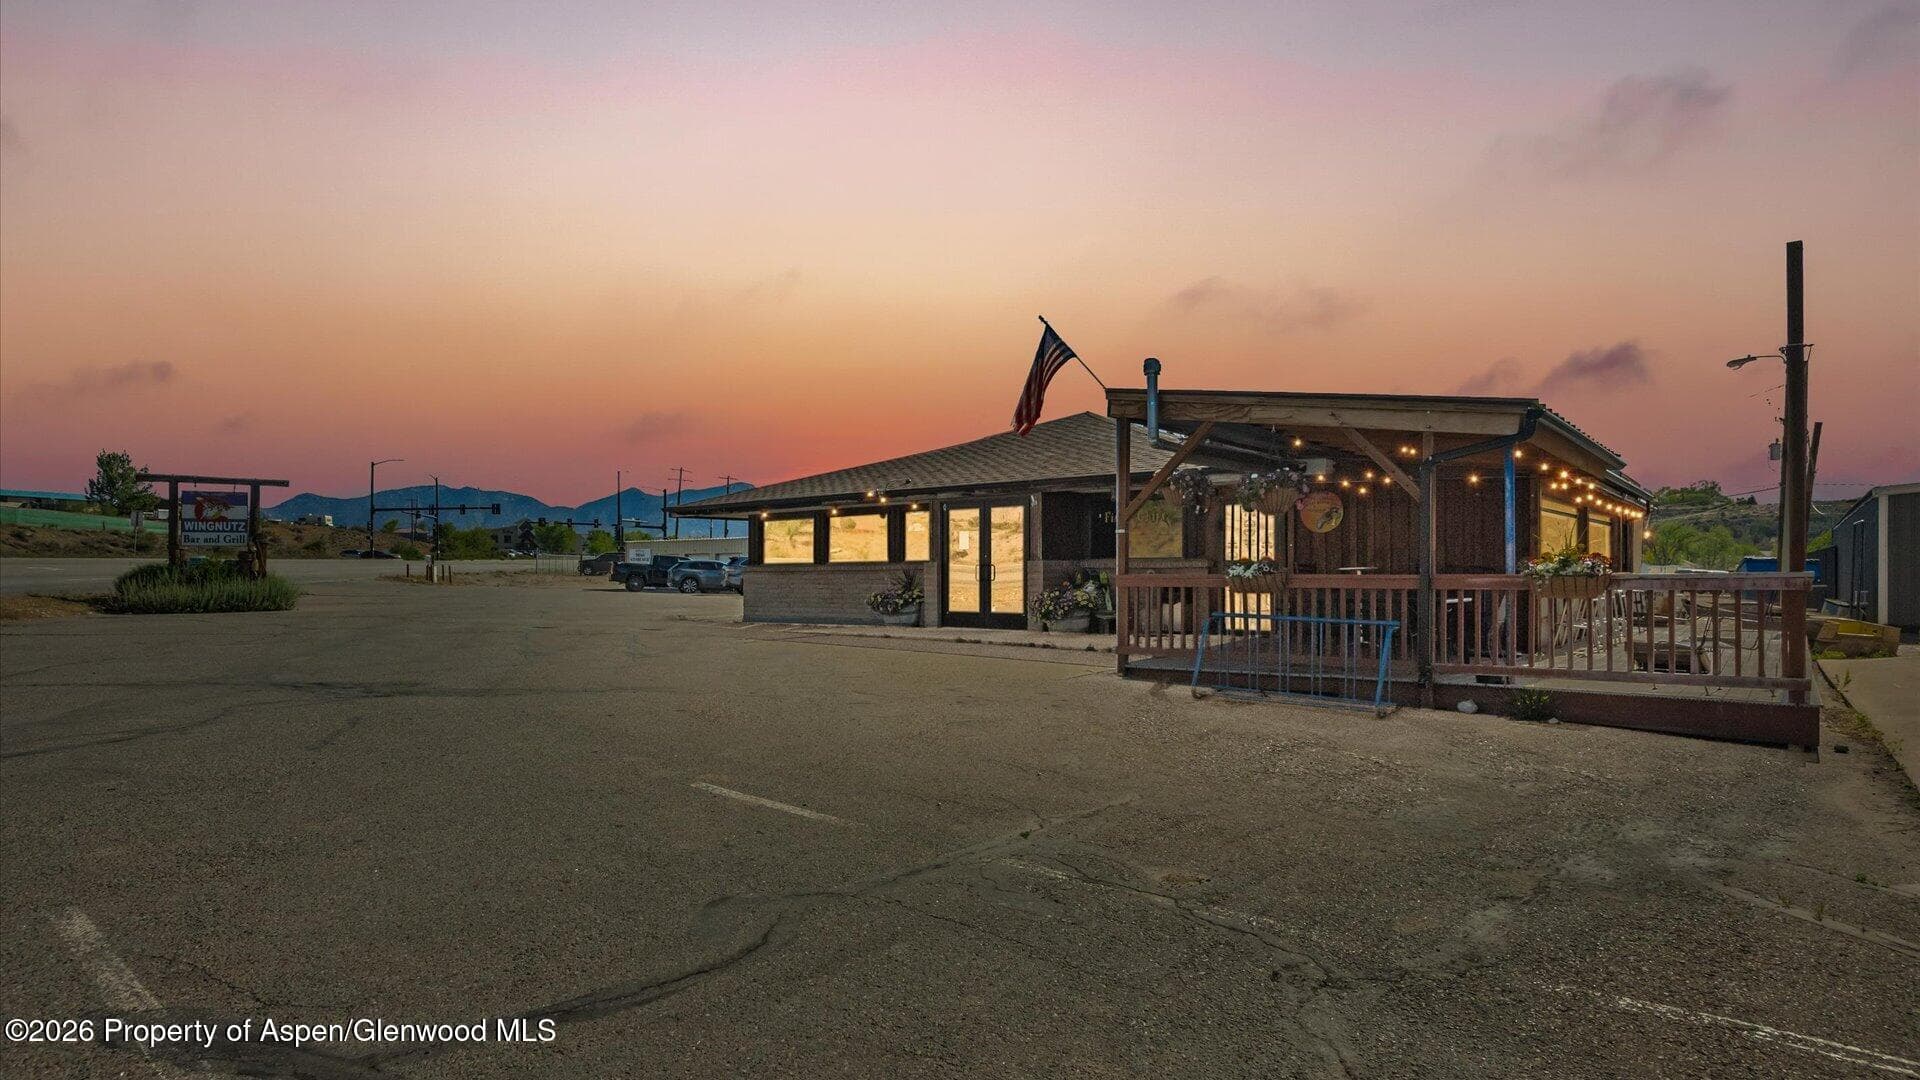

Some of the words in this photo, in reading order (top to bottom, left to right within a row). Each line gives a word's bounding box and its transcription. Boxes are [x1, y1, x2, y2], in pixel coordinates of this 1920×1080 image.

[184, 521, 246, 531] WINGNUTZ
[184, 534, 201, 544] Bar
[204, 534, 220, 544] and
[223, 534, 245, 544] Grill
